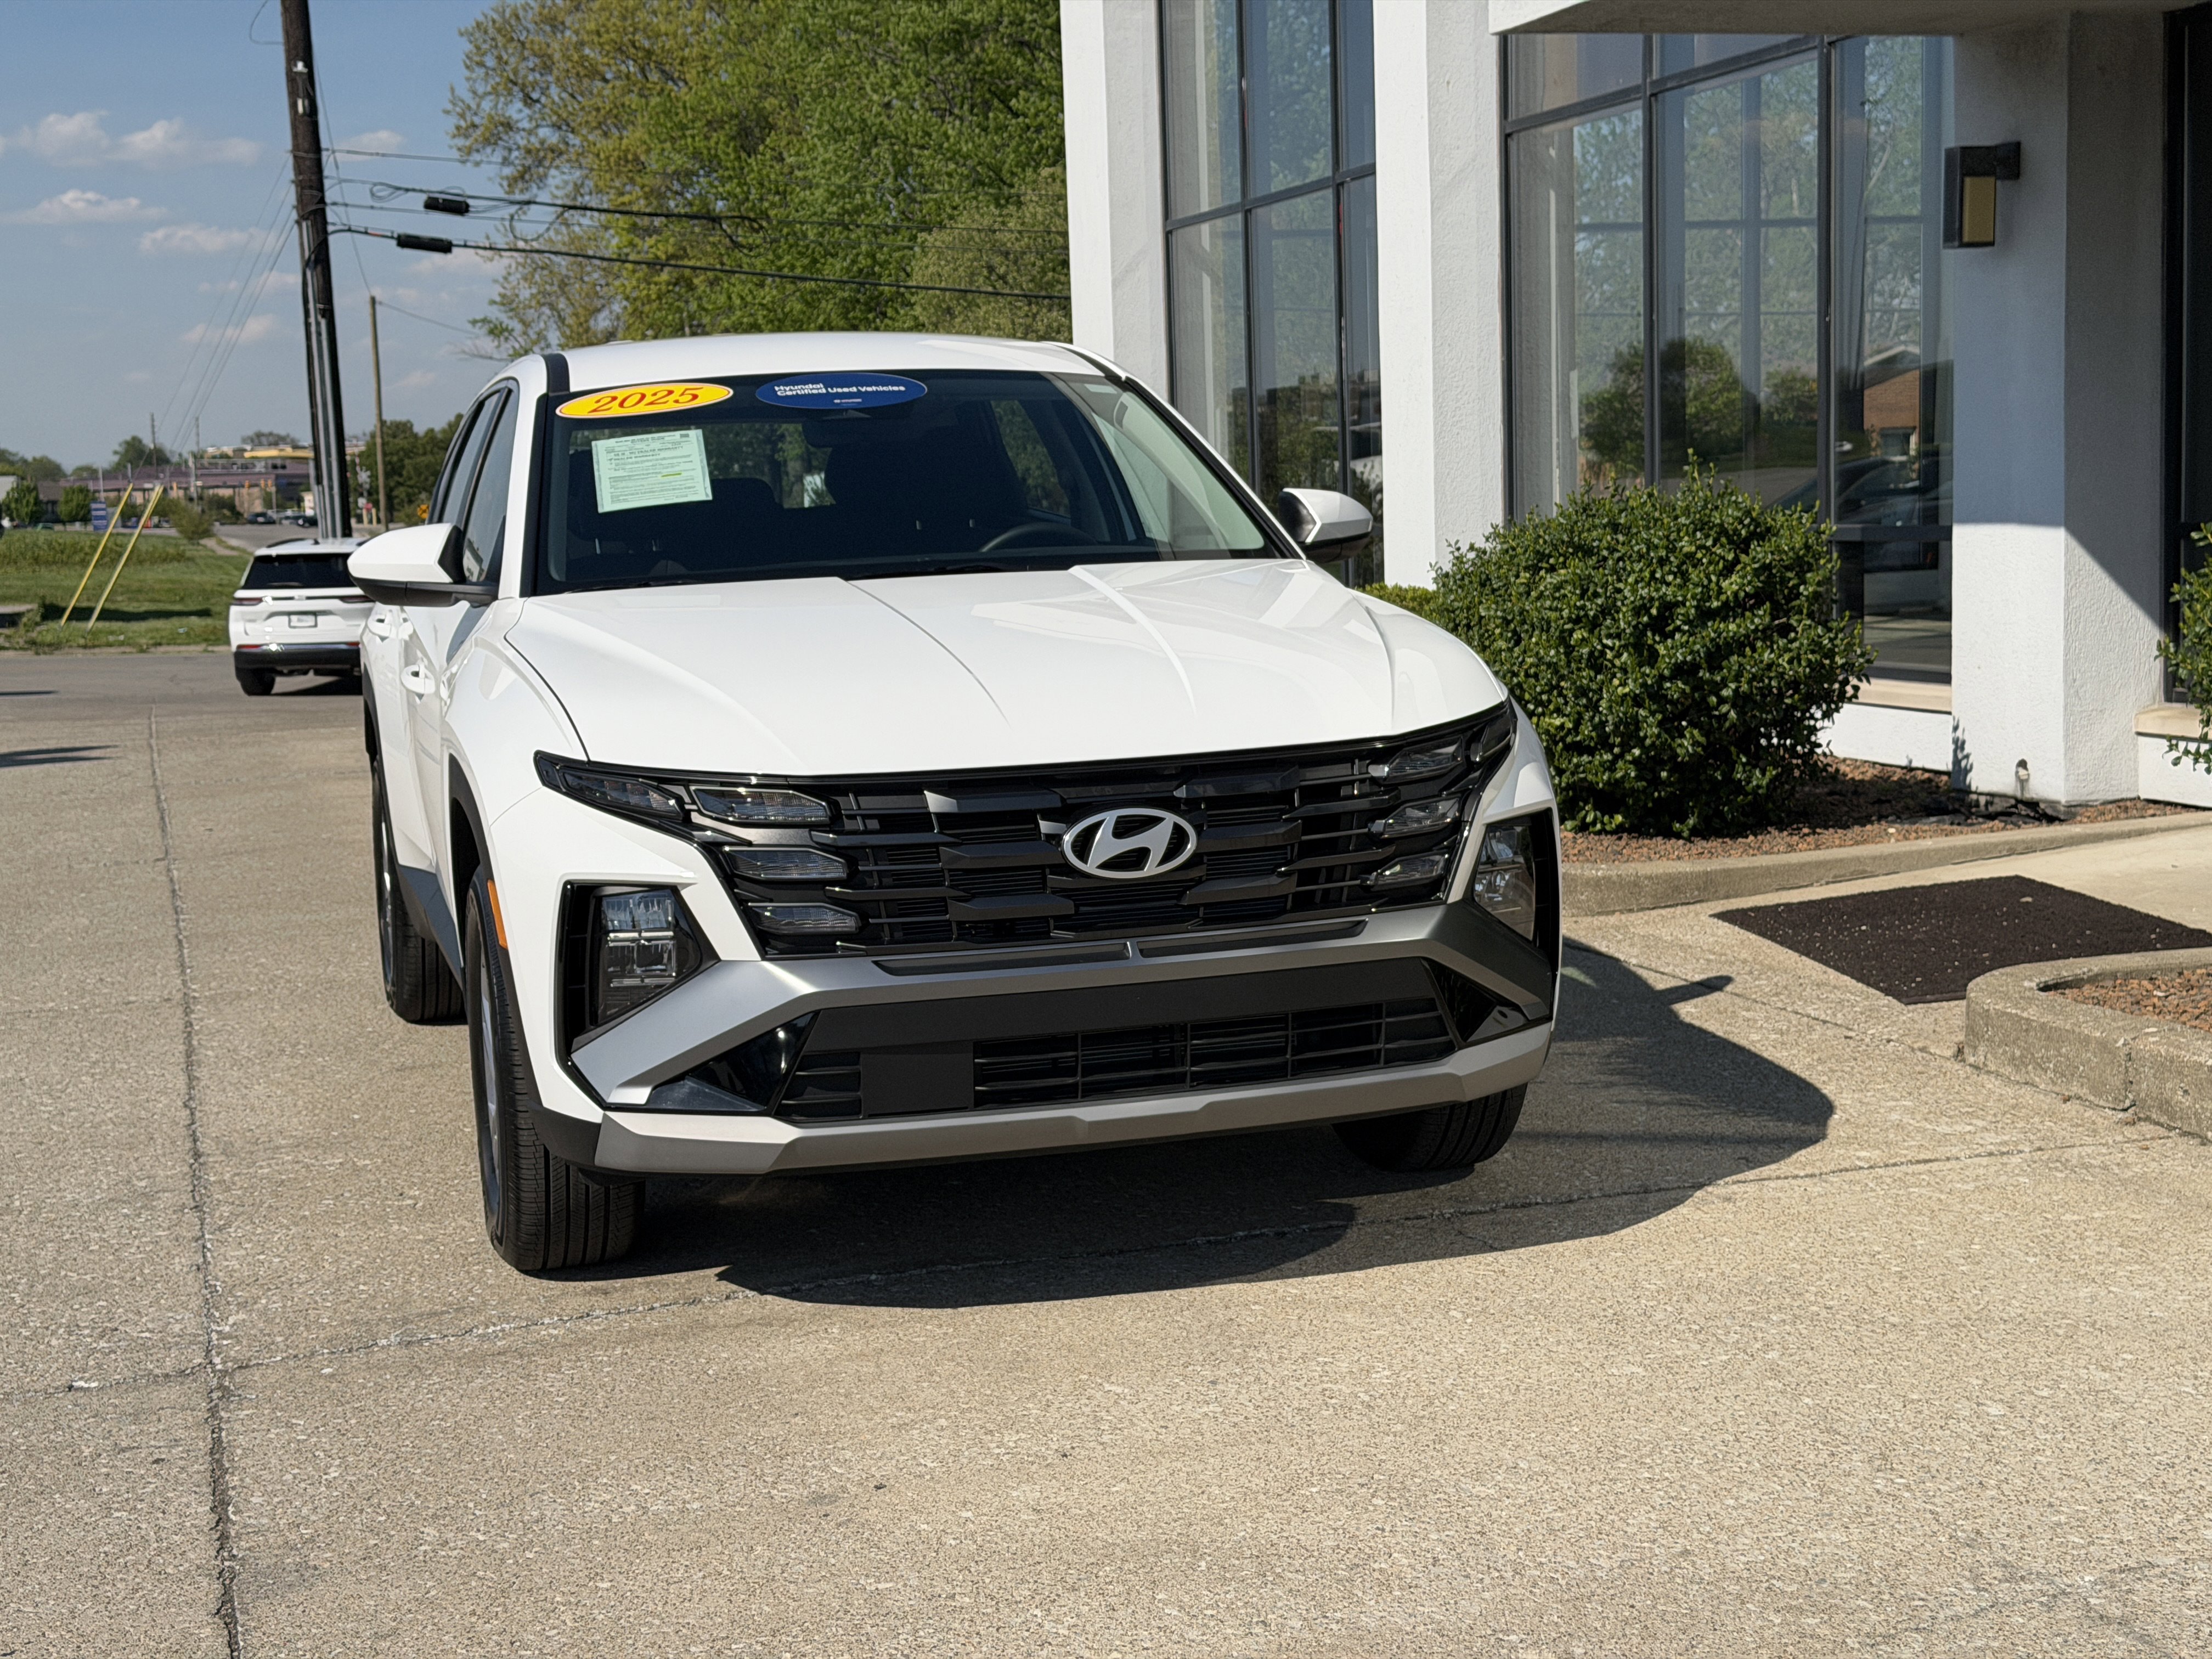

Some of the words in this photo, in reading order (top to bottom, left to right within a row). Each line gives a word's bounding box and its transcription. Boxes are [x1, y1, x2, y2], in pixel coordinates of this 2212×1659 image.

[774, 383, 824, 391] Hyundai
[777, 387, 827, 396] Certified
[588, 387, 704, 414] 2025
